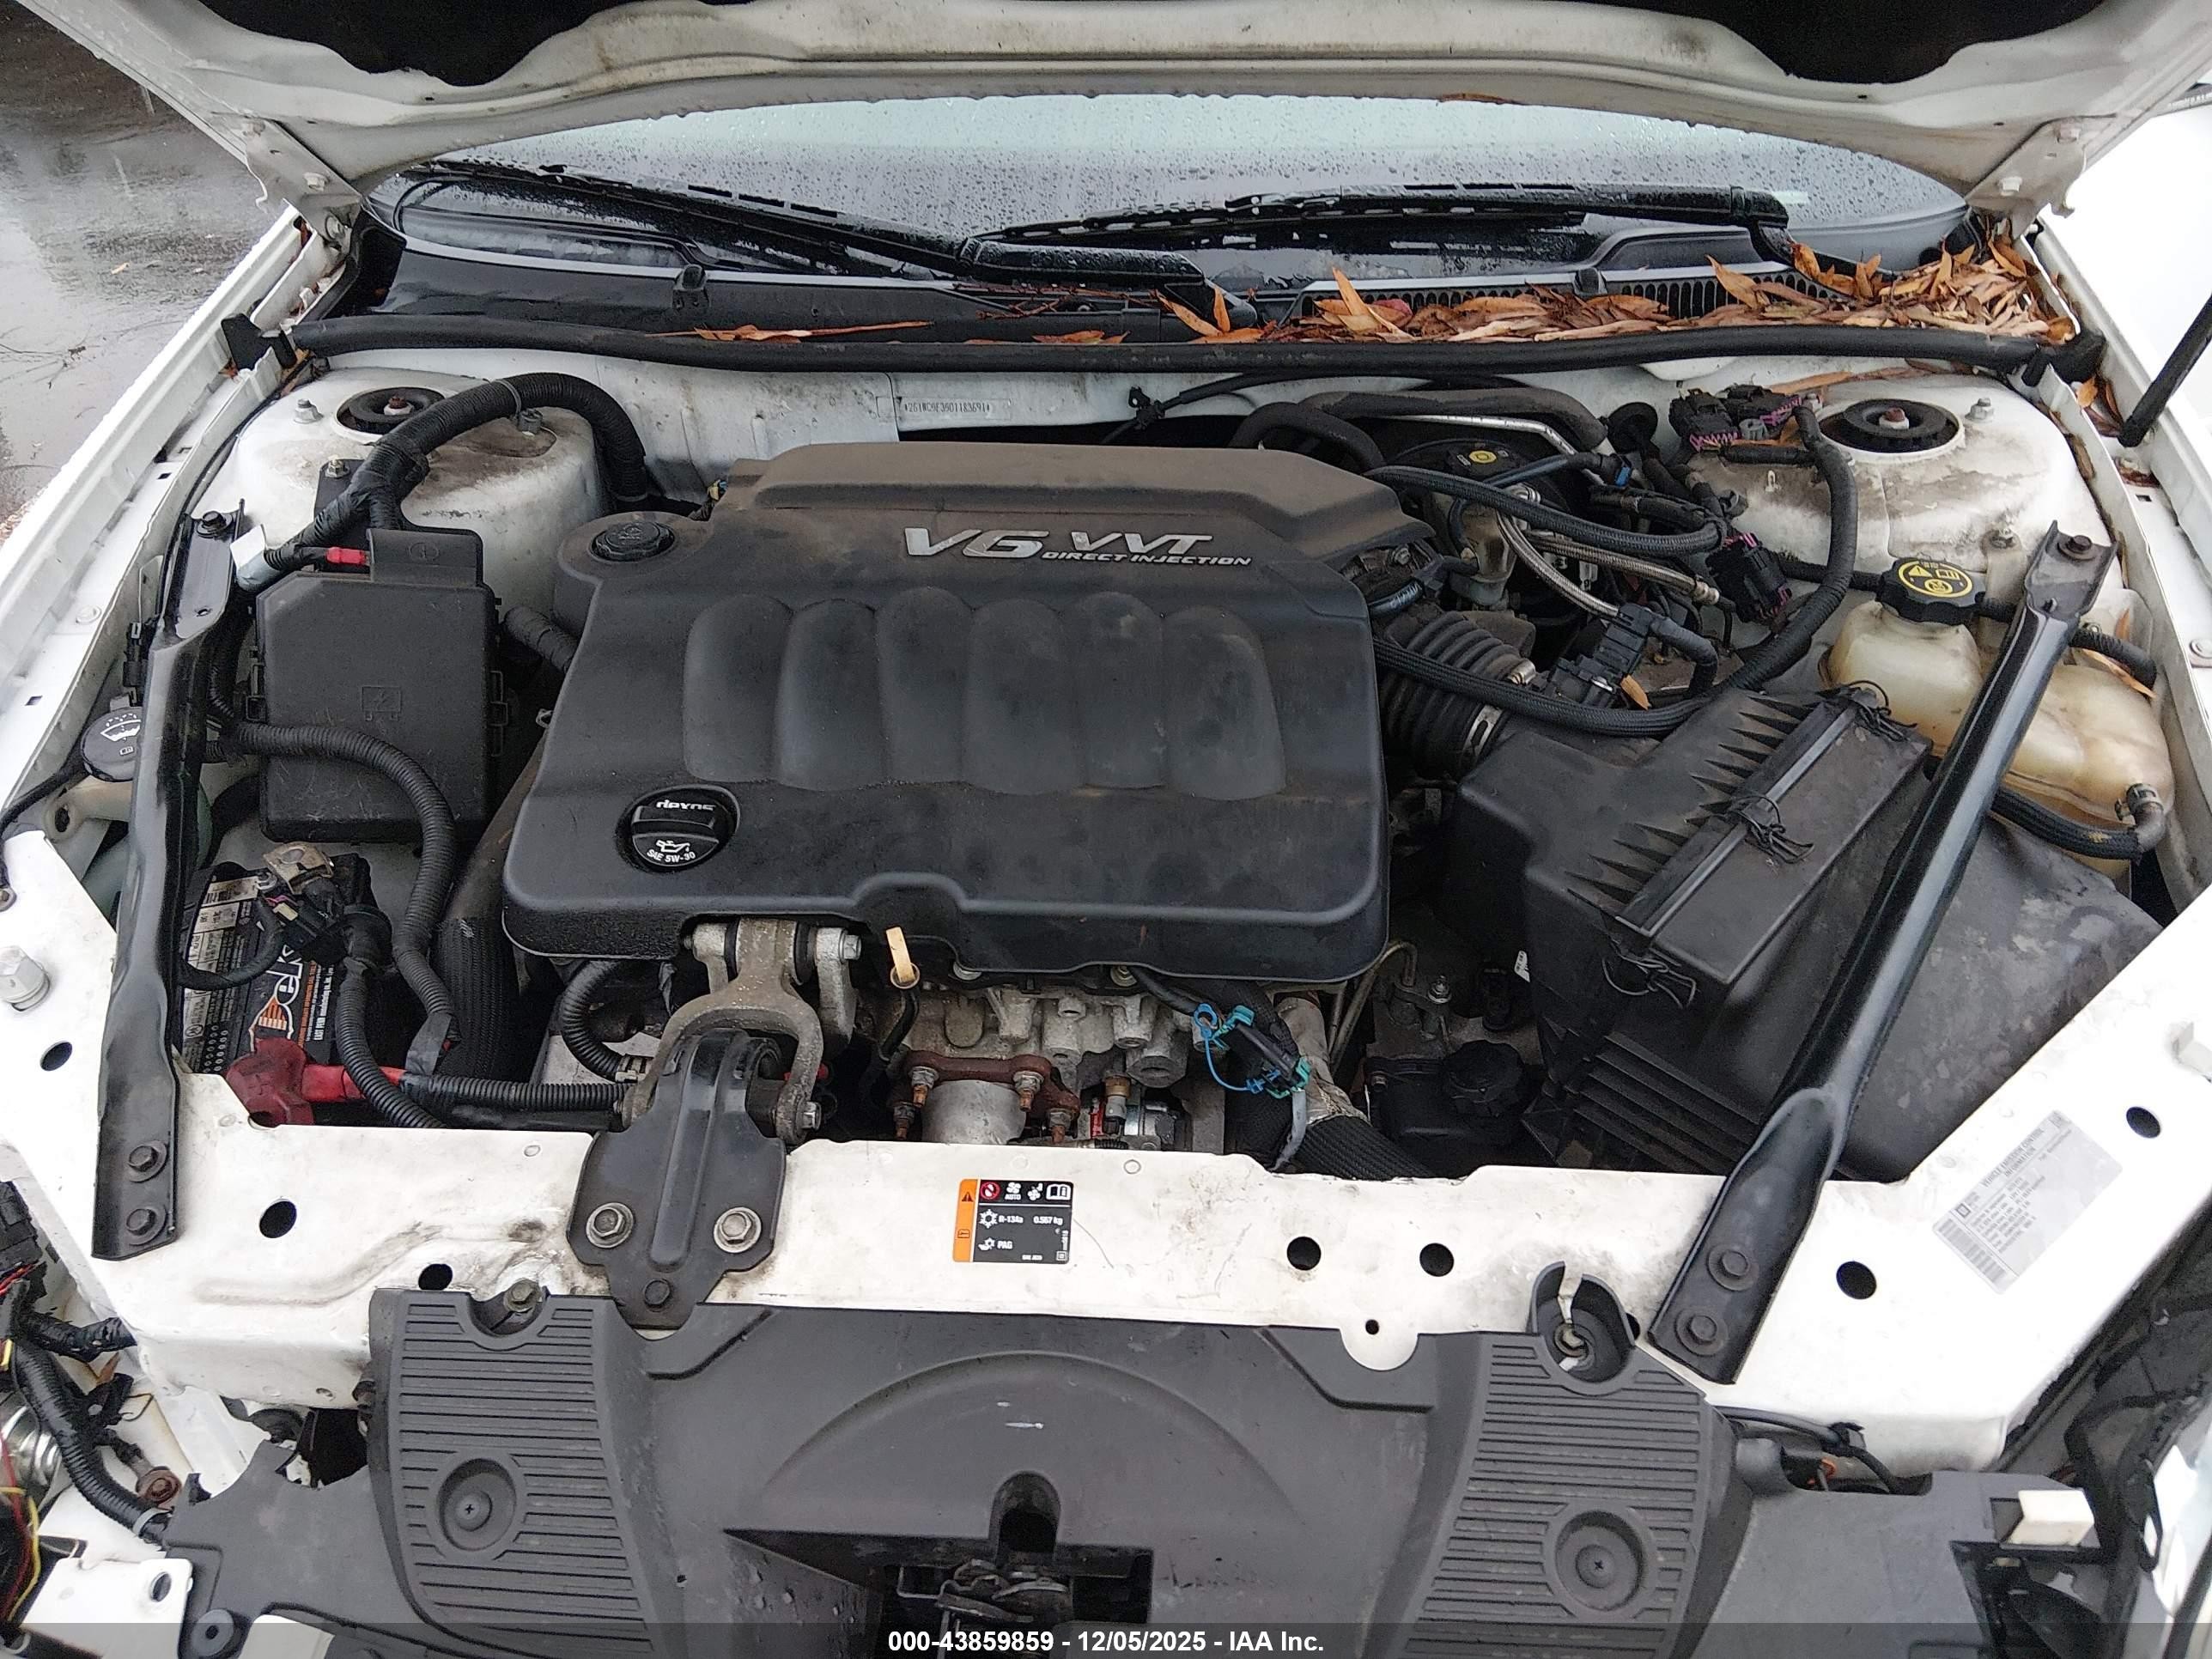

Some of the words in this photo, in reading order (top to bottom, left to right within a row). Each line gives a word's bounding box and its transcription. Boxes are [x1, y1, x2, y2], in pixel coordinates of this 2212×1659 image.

[904, 527, 1049, 558] V6
[1071, 531, 1213, 556] VVT
[1042, 550, 1127, 562] DIRECT
[1129, 553, 1251, 567] INJECTION
[647, 850, 665, 862] SAE
[665, 851, 696, 863] 5W-30
[997, 1240, 1013, 1249] PAG
